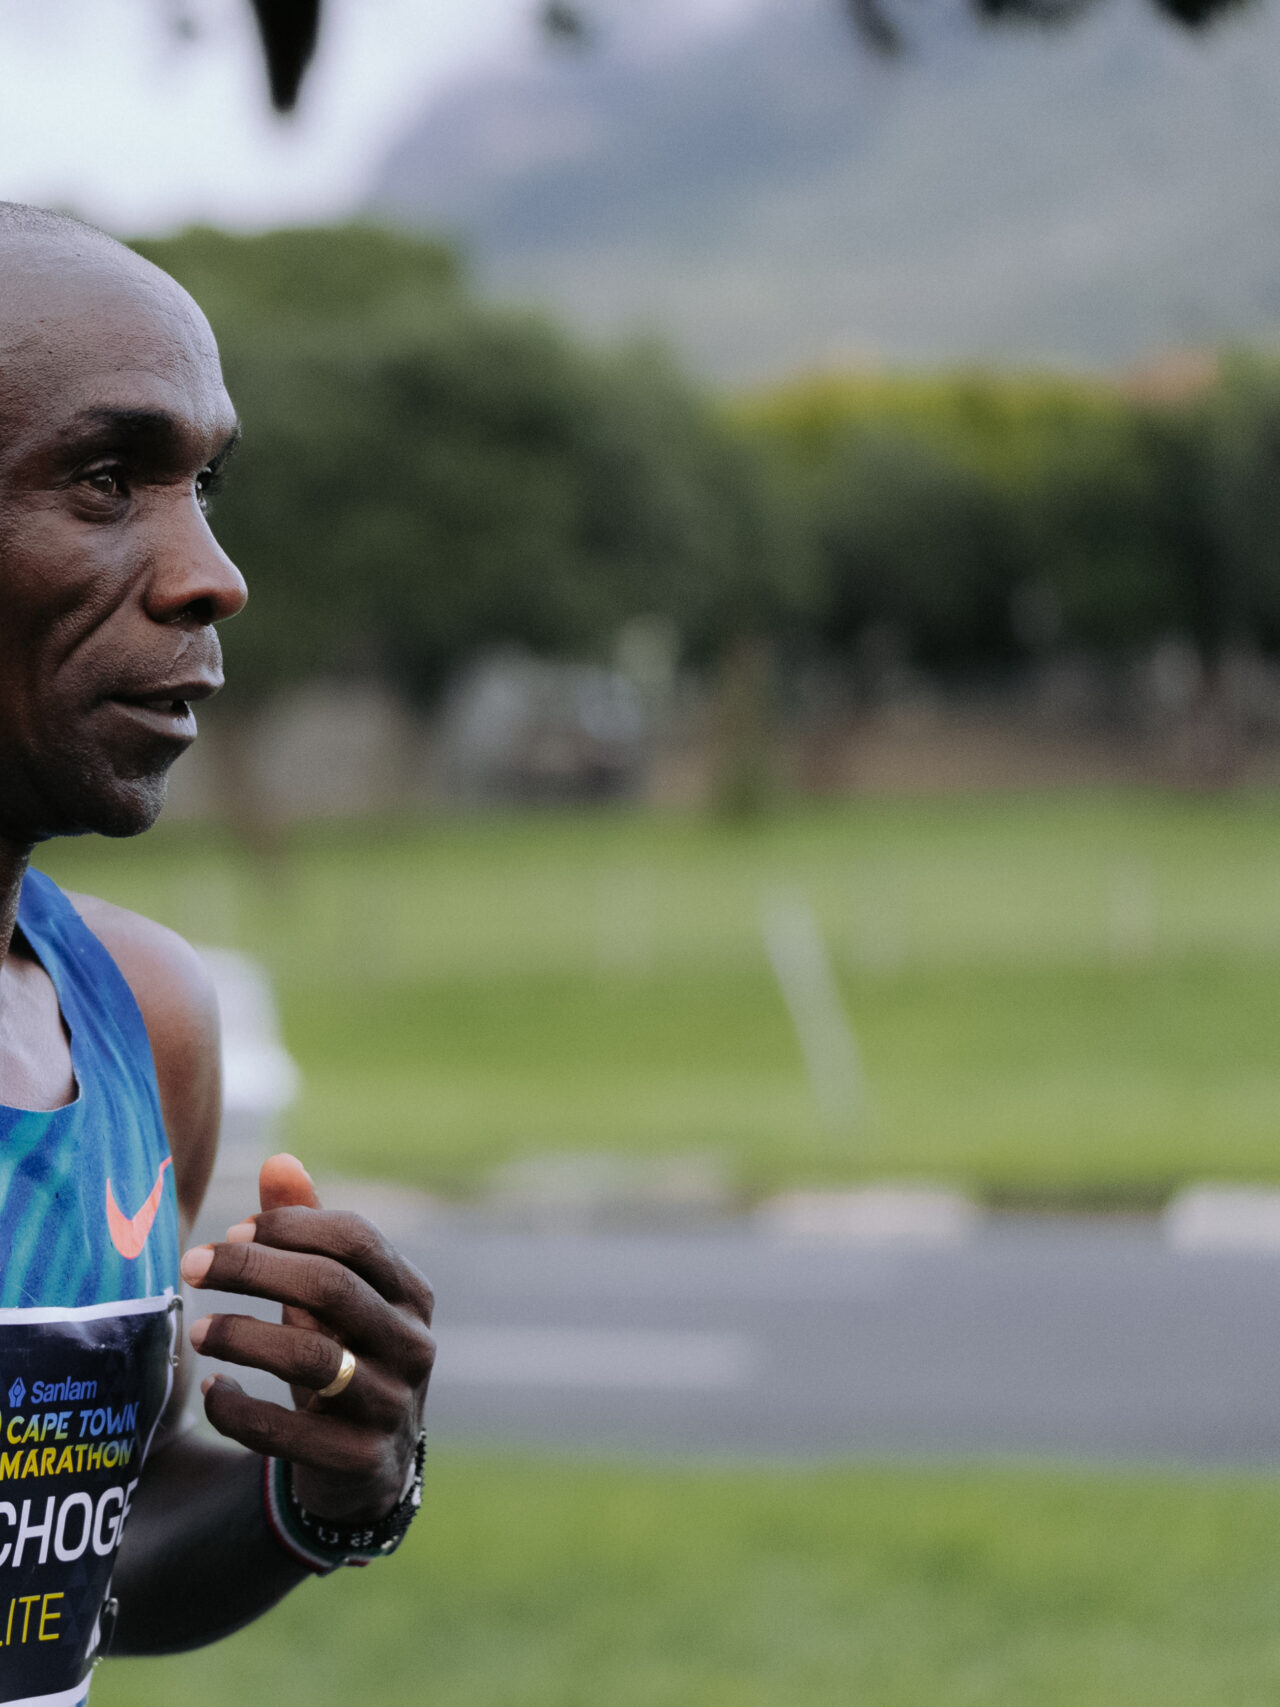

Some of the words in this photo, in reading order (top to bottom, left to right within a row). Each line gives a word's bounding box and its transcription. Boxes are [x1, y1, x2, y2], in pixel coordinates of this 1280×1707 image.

[31, 1376, 97, 1404] Sanlam
[7, 1411, 73, 1444] CAPE
[79, 1401, 139, 1437] TOWN
